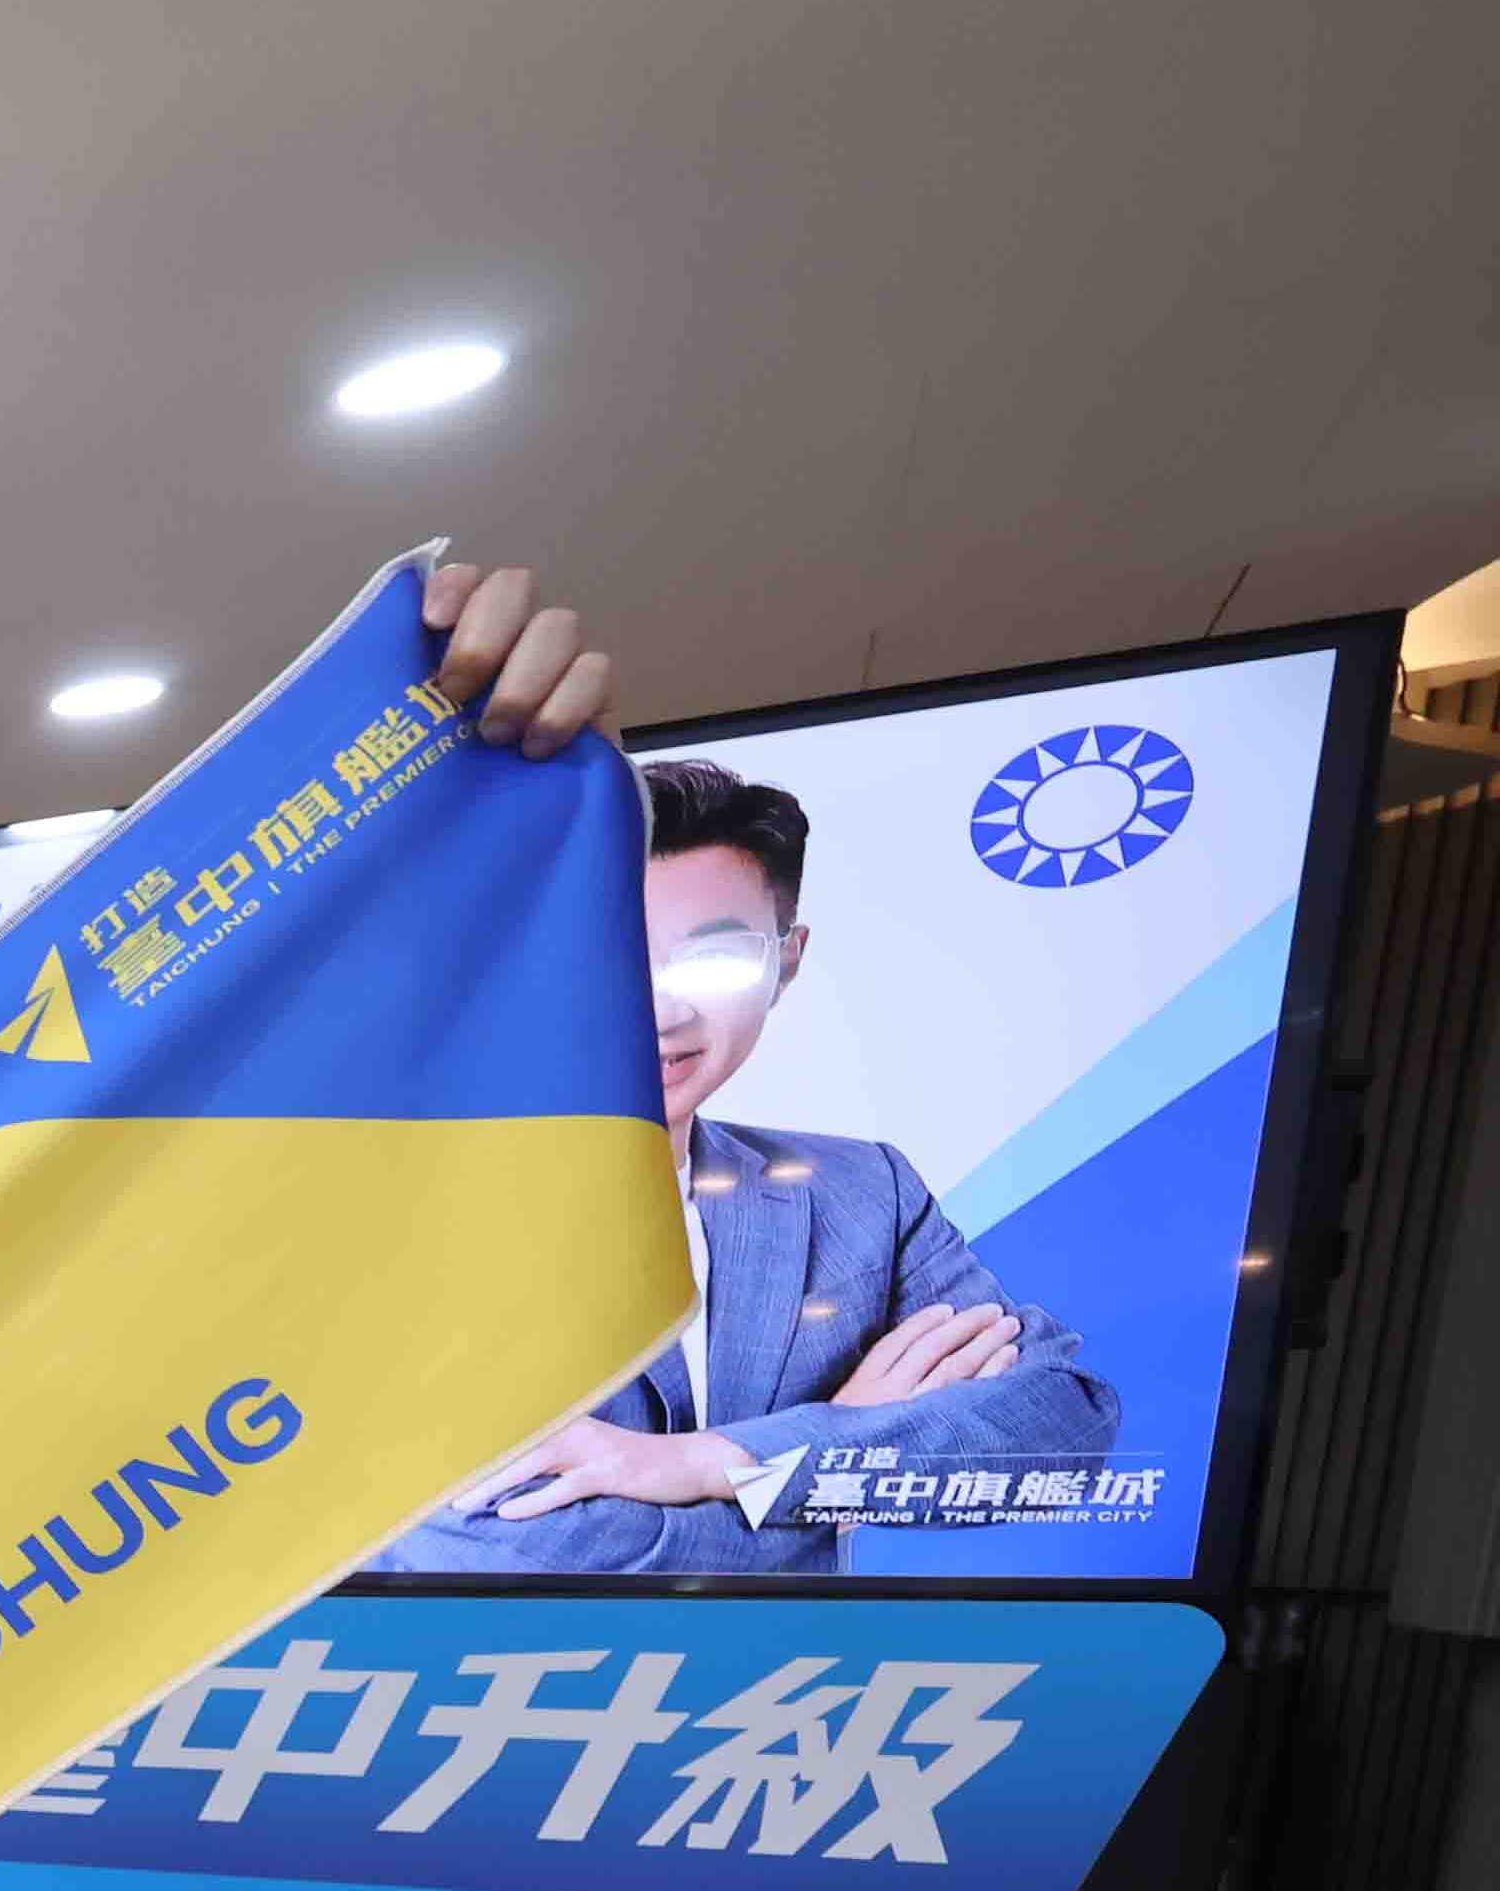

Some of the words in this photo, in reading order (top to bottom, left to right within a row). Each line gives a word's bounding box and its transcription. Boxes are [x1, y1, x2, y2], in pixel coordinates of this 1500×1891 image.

[128, 899, 261, 1007] TAICHUNG
[288, 830, 343, 874] THE
[345, 736, 455, 830] PREMIER
[79, 866, 178, 954] 打造
[816, 1446, 901, 1470] 打造
[804, 1468, 1165, 1508] 臺中旗艦城
[802, 1510, 915, 1524] TAICHUNG
[942, 1510, 988, 1523] THE
[990, 1510, 1091, 1523] PREMIER
[1095, 1510, 1155, 1523] CITY
